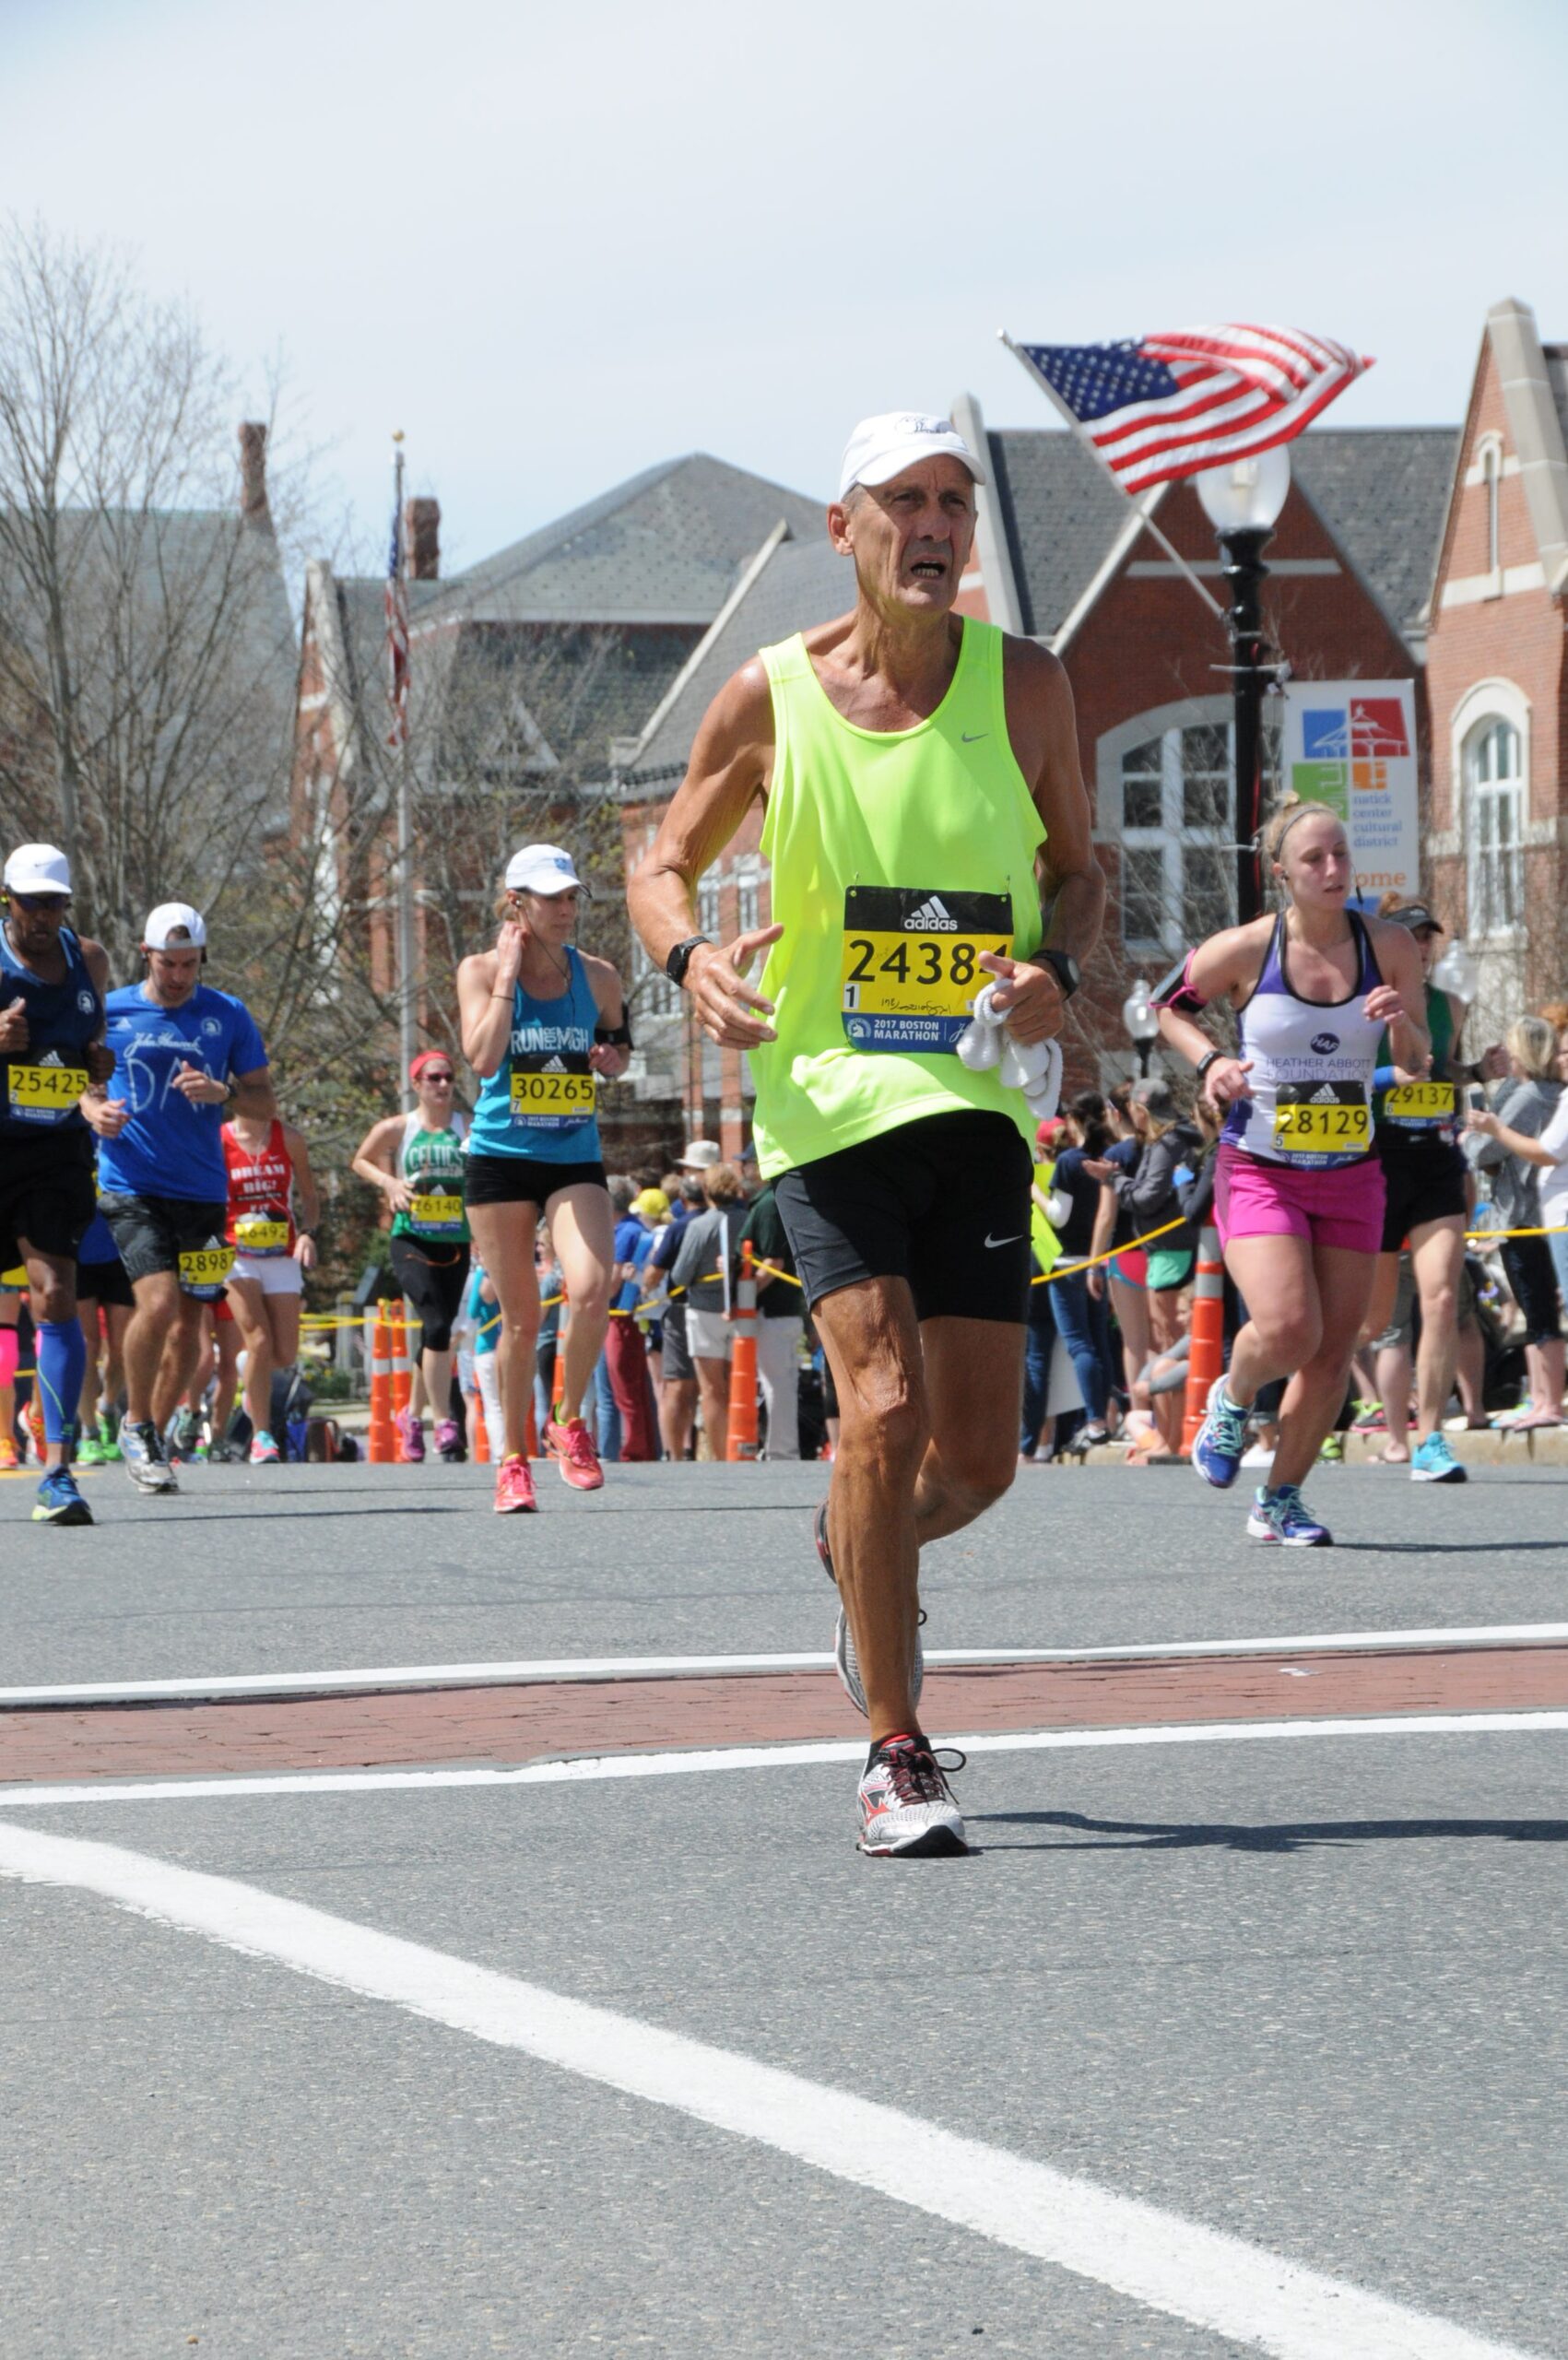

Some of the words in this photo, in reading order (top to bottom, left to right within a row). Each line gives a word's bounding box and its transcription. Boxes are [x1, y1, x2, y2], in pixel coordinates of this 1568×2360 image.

[1353, 793, 1391, 805] natick
[1353, 808, 1392, 819] center
[1353, 820, 1402, 833] cultural
[1353, 835, 1397, 848] district
[1354, 871, 1407, 887] ome
[904, 917, 958, 931] adidas
[845, 985, 855, 1008] 1
[875, 1019, 896, 1028] 2017
[899, 1020, 939, 1030] BOSTON
[511, 1027, 544, 1055] RUN
[544, 1027, 557, 1050] FOR
[557, 1026, 589, 1053] MGH
[874, 1030, 939, 1041] MARATHON
[1312, 1035, 1338, 1051] HAF
[1267, 1058, 1324, 1068] HEATHER
[1327, 1059, 1372, 1068] ABBOTT
[12, 1070, 88, 1094] 25425
[514, 1078, 594, 1100] 30265
[1309, 1096, 1340, 1104] adidas
[1389, 1086, 1452, 1105] 29137
[513, 1100, 521, 1112] 7
[1279, 1109, 1368, 1134] 28129
[1275, 1135, 1283, 1147] 5
[410, 1144, 463, 1170] CELTICS
[230, 1164, 285, 1181] DREAM
[238, 1223, 287, 1239] 6492
